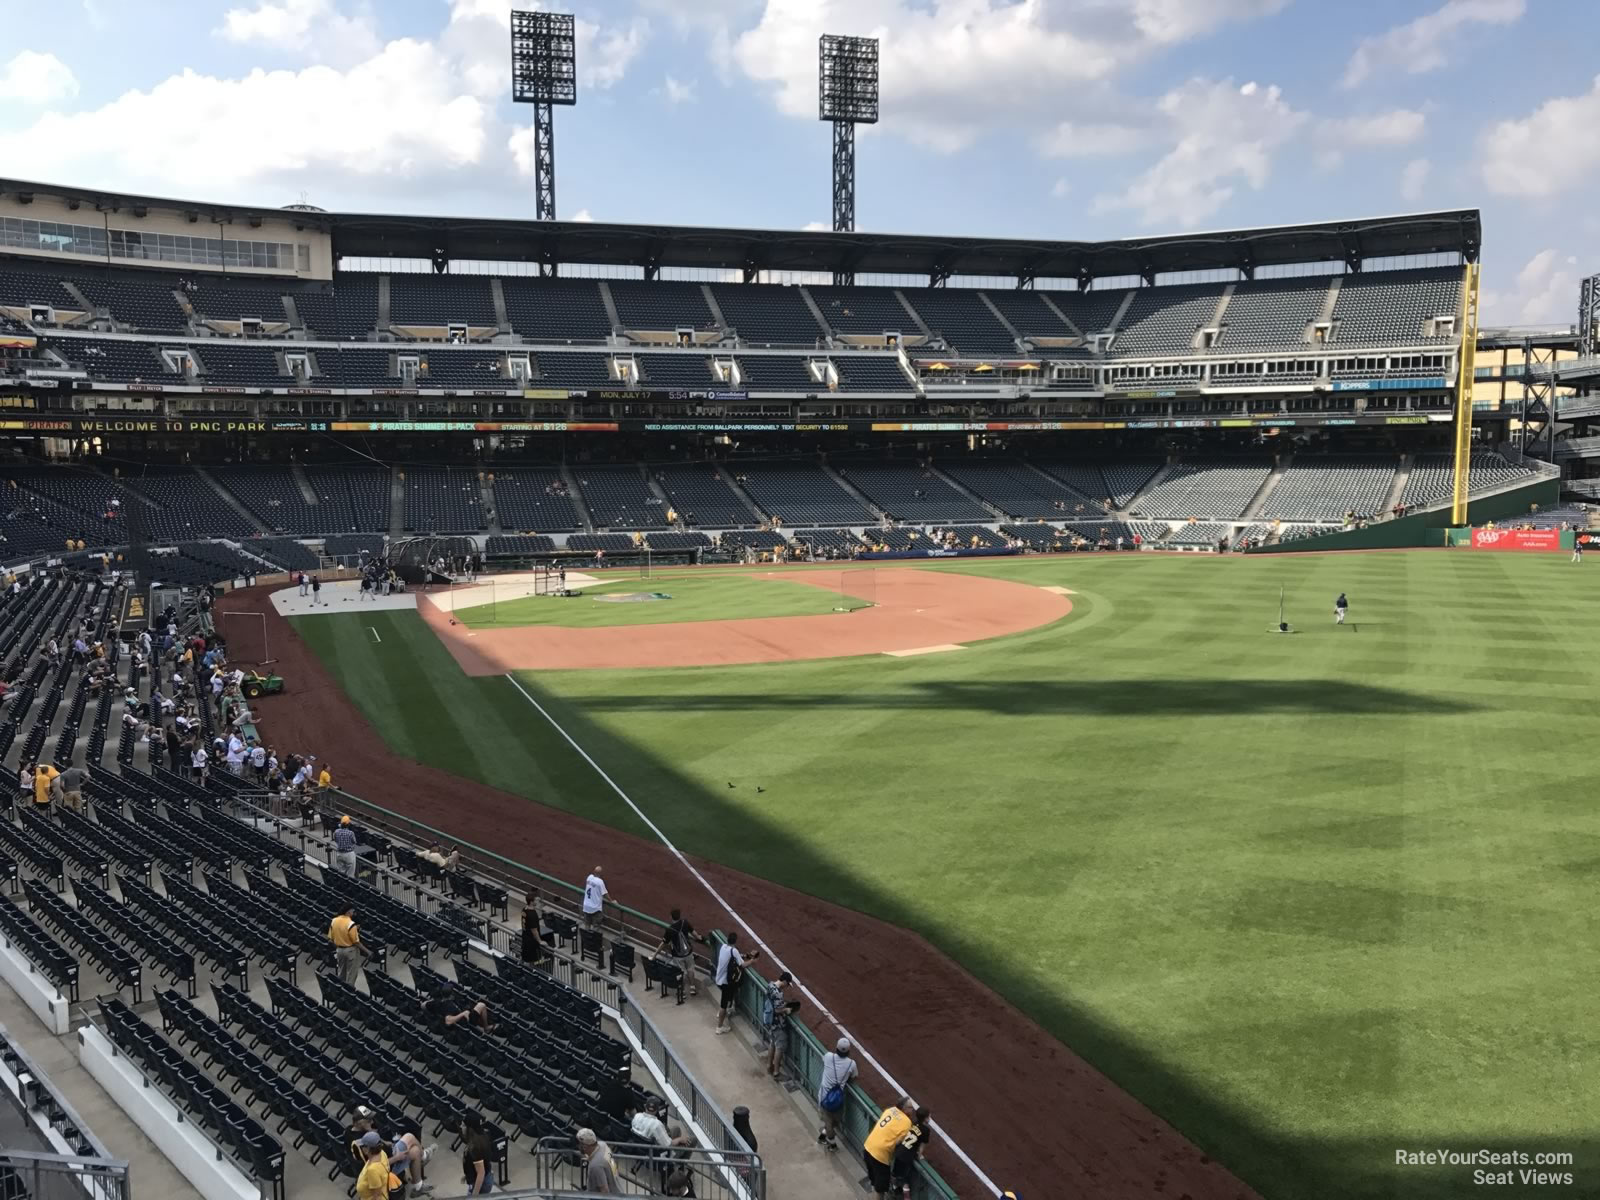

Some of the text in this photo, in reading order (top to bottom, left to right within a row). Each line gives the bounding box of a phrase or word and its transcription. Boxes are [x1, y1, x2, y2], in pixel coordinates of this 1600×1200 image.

[1340, 382, 1370, 390] KOPPERS
[621, 391, 640, 399] JULY
[642, 391, 651, 399] 17
[668, 391, 687, 400] 5:54
[80, 421, 157, 431] WELCOME
[165, 422, 182, 431] TO
[190, 422, 220, 431] PNC
[228, 422, 266, 431] PARK
[382, 422, 476, 431] PIRATES SUMMER 6-PACK
[501, 423, 533, 431] STARTING
[586, 887, 592, 899] 4
[879, 1115, 892, 1128] 8
